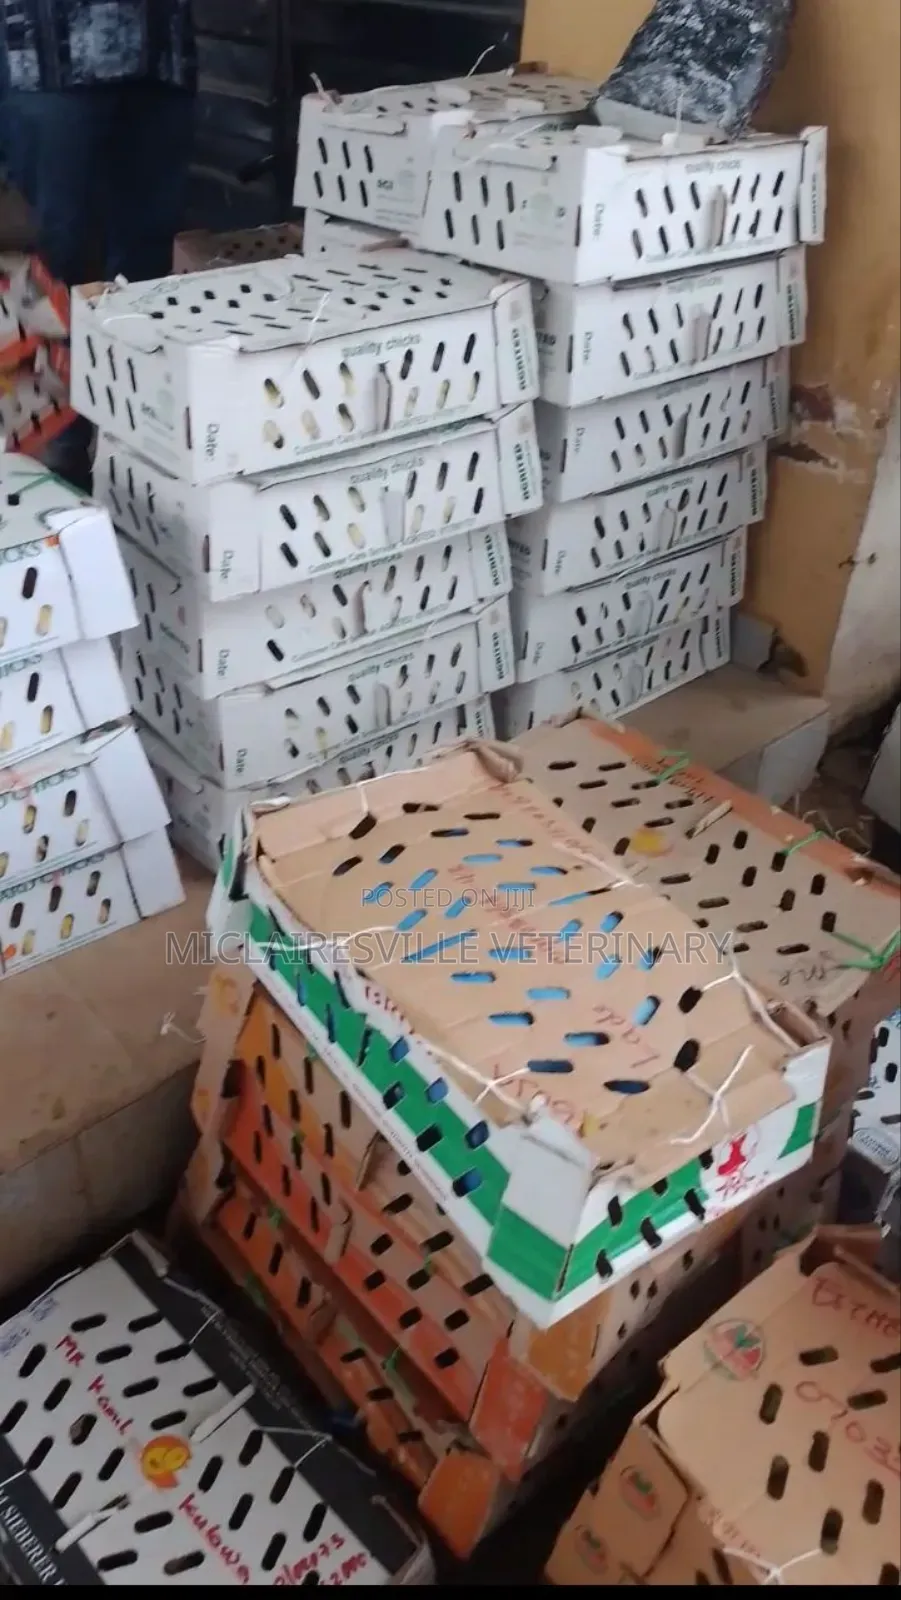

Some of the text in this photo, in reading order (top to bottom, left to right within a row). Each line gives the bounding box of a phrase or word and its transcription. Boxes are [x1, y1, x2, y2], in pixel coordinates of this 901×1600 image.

[341, 333, 421, 359] quality chicks
[205, 423, 220, 462] Date:
[350, 456, 425, 484] quality chicks
[348, 652, 416, 682] quality chicks
